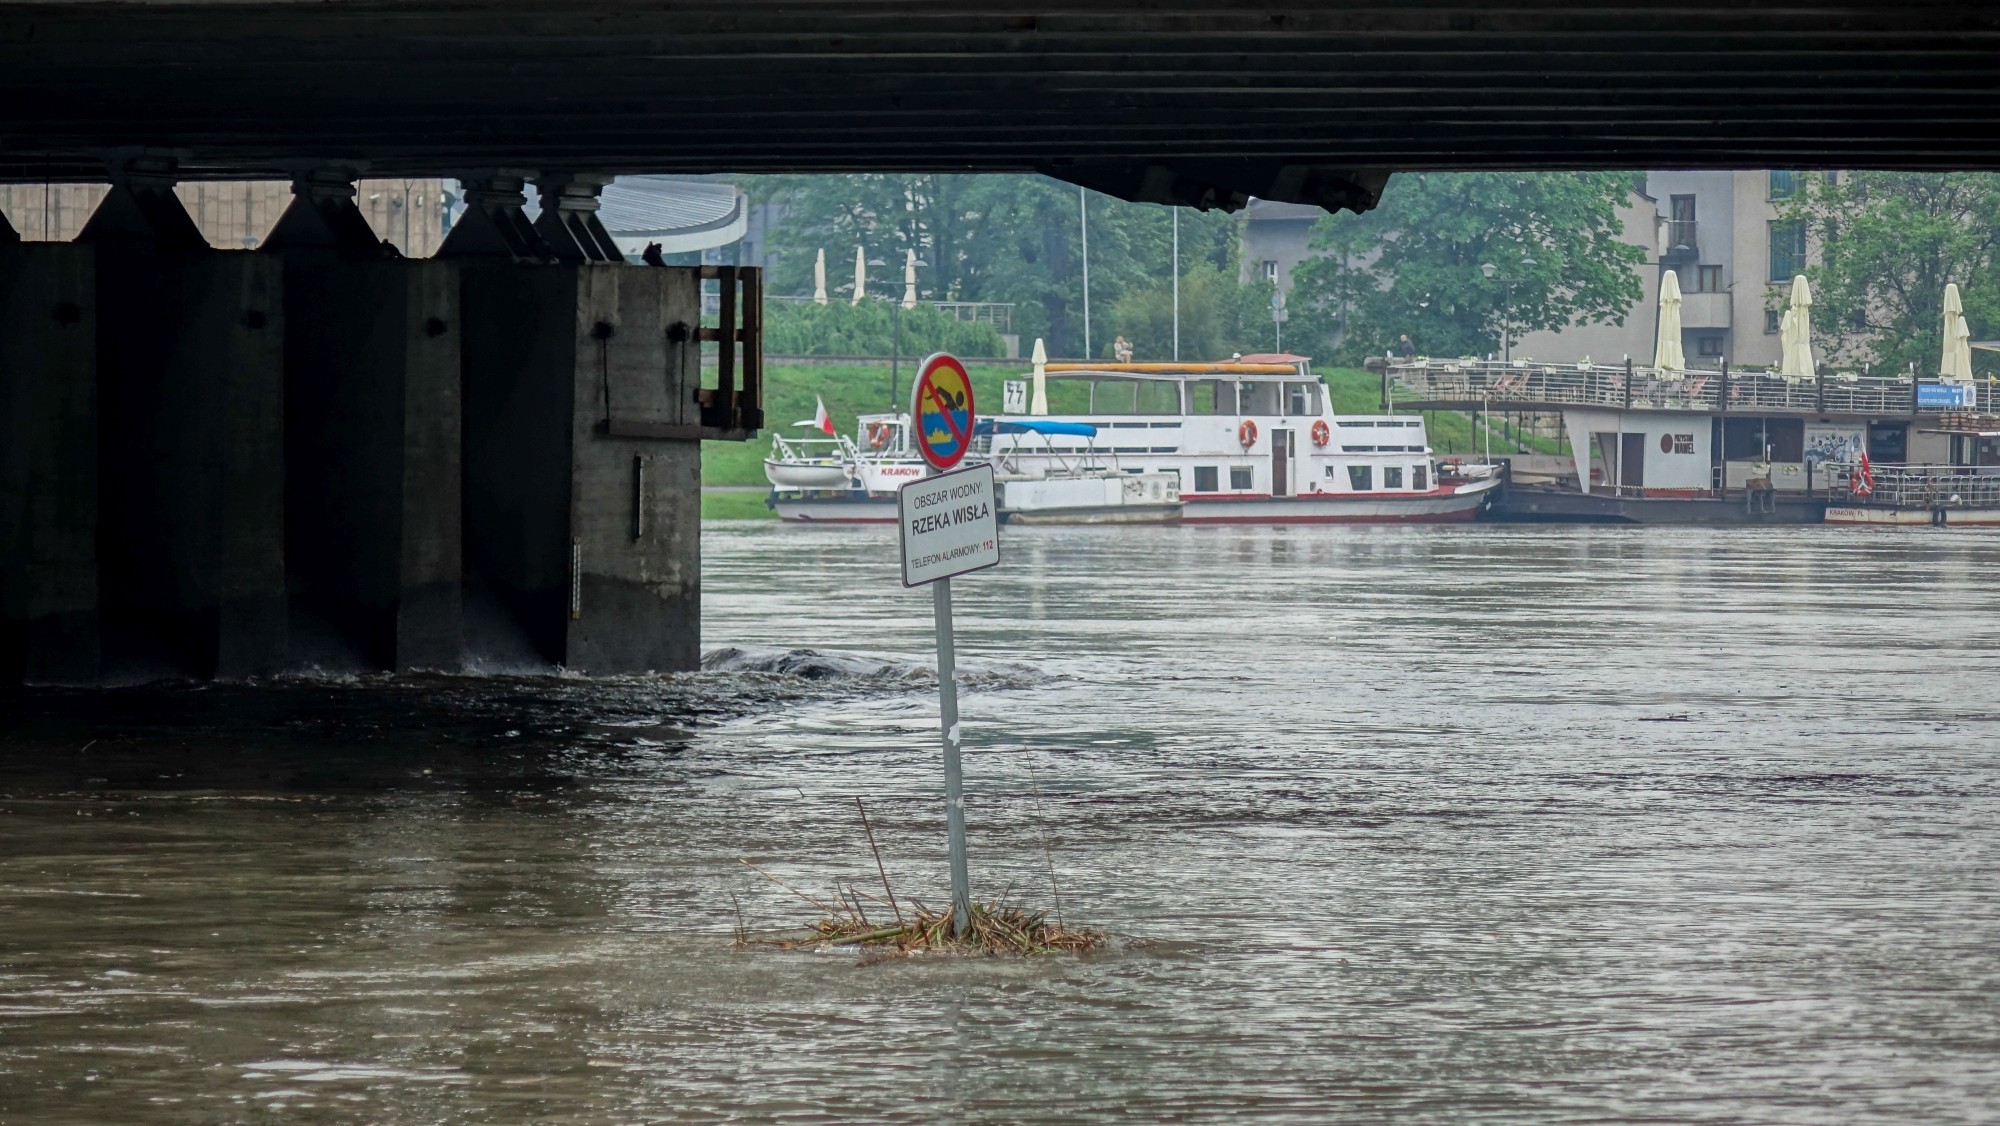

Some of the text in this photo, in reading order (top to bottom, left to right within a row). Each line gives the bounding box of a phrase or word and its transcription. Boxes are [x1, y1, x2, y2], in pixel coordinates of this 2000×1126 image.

[1674, 443, 1695, 454] WAWEL
[914, 481, 984, 510] OBSZAR WODNY:
[912, 502, 989, 536] RZEKA WISŁA
[911, 540, 994, 569] TELEFON ALARMOWY: 112
